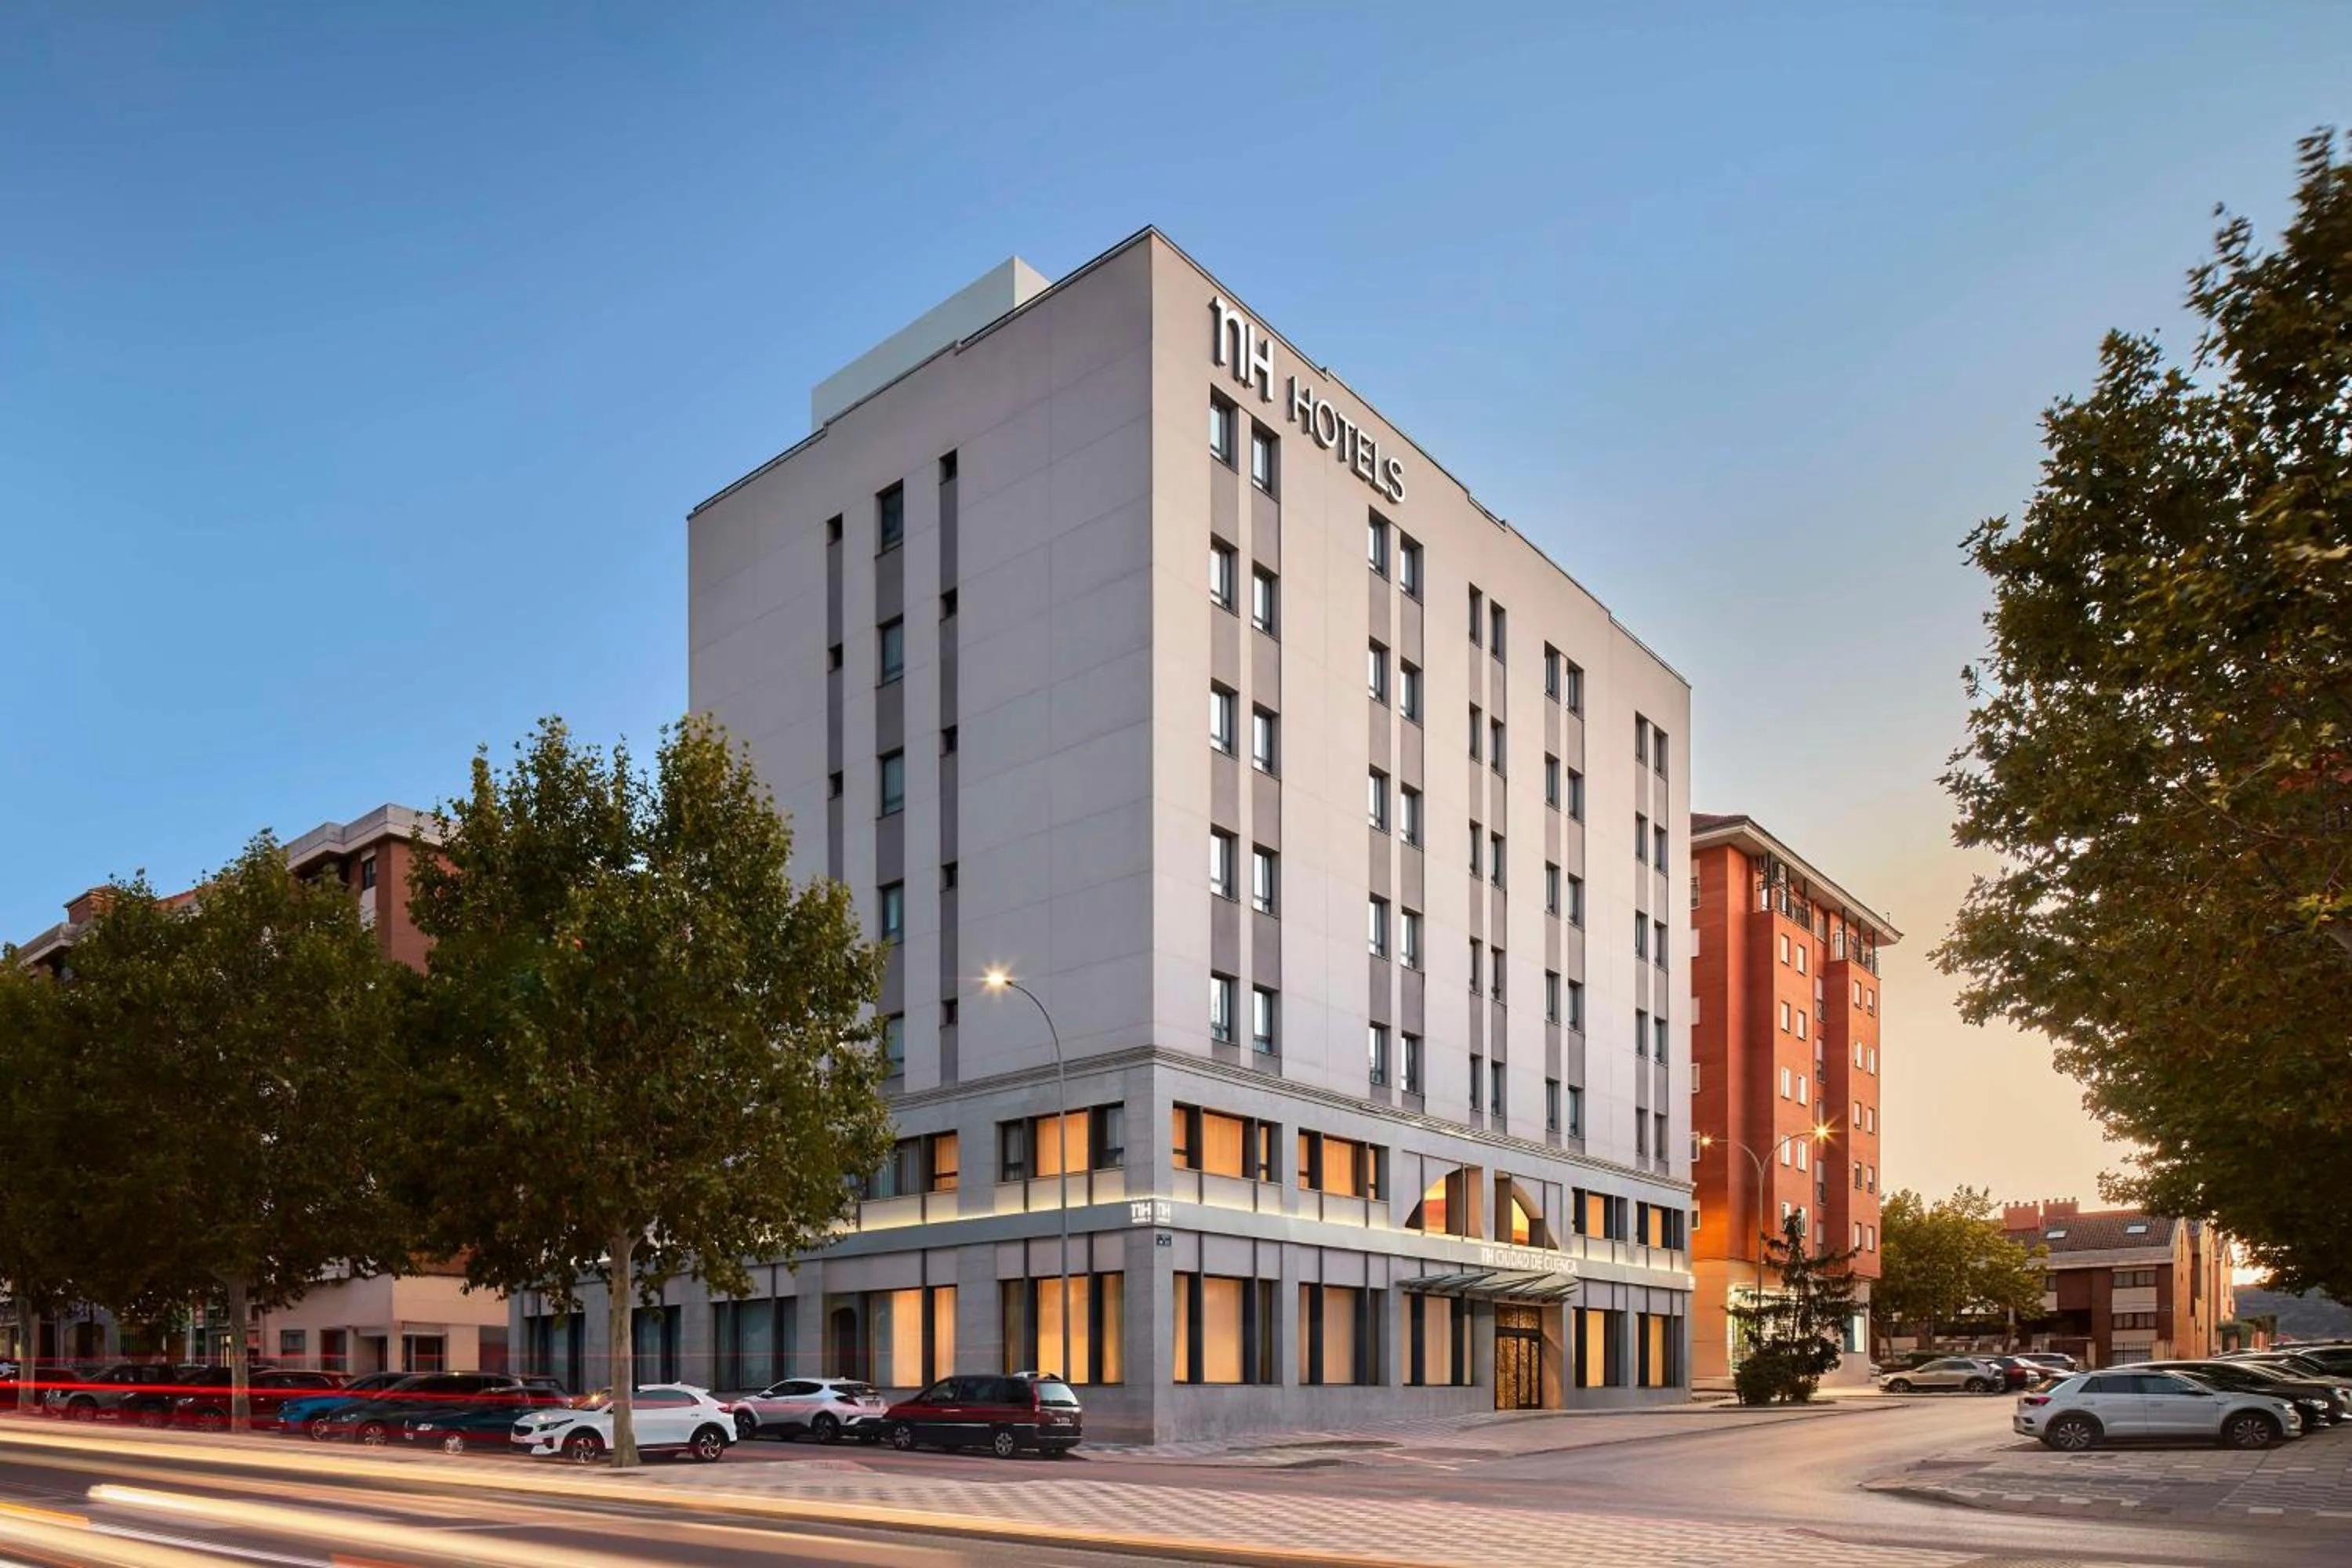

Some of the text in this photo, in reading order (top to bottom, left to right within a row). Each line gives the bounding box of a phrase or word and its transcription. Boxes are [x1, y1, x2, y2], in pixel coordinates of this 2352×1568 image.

[1287, 375, 1406, 504] HOTELS
[1495, 1249, 1529, 1269] CIUDAD
[1530, 1254, 1543, 1270] DE
